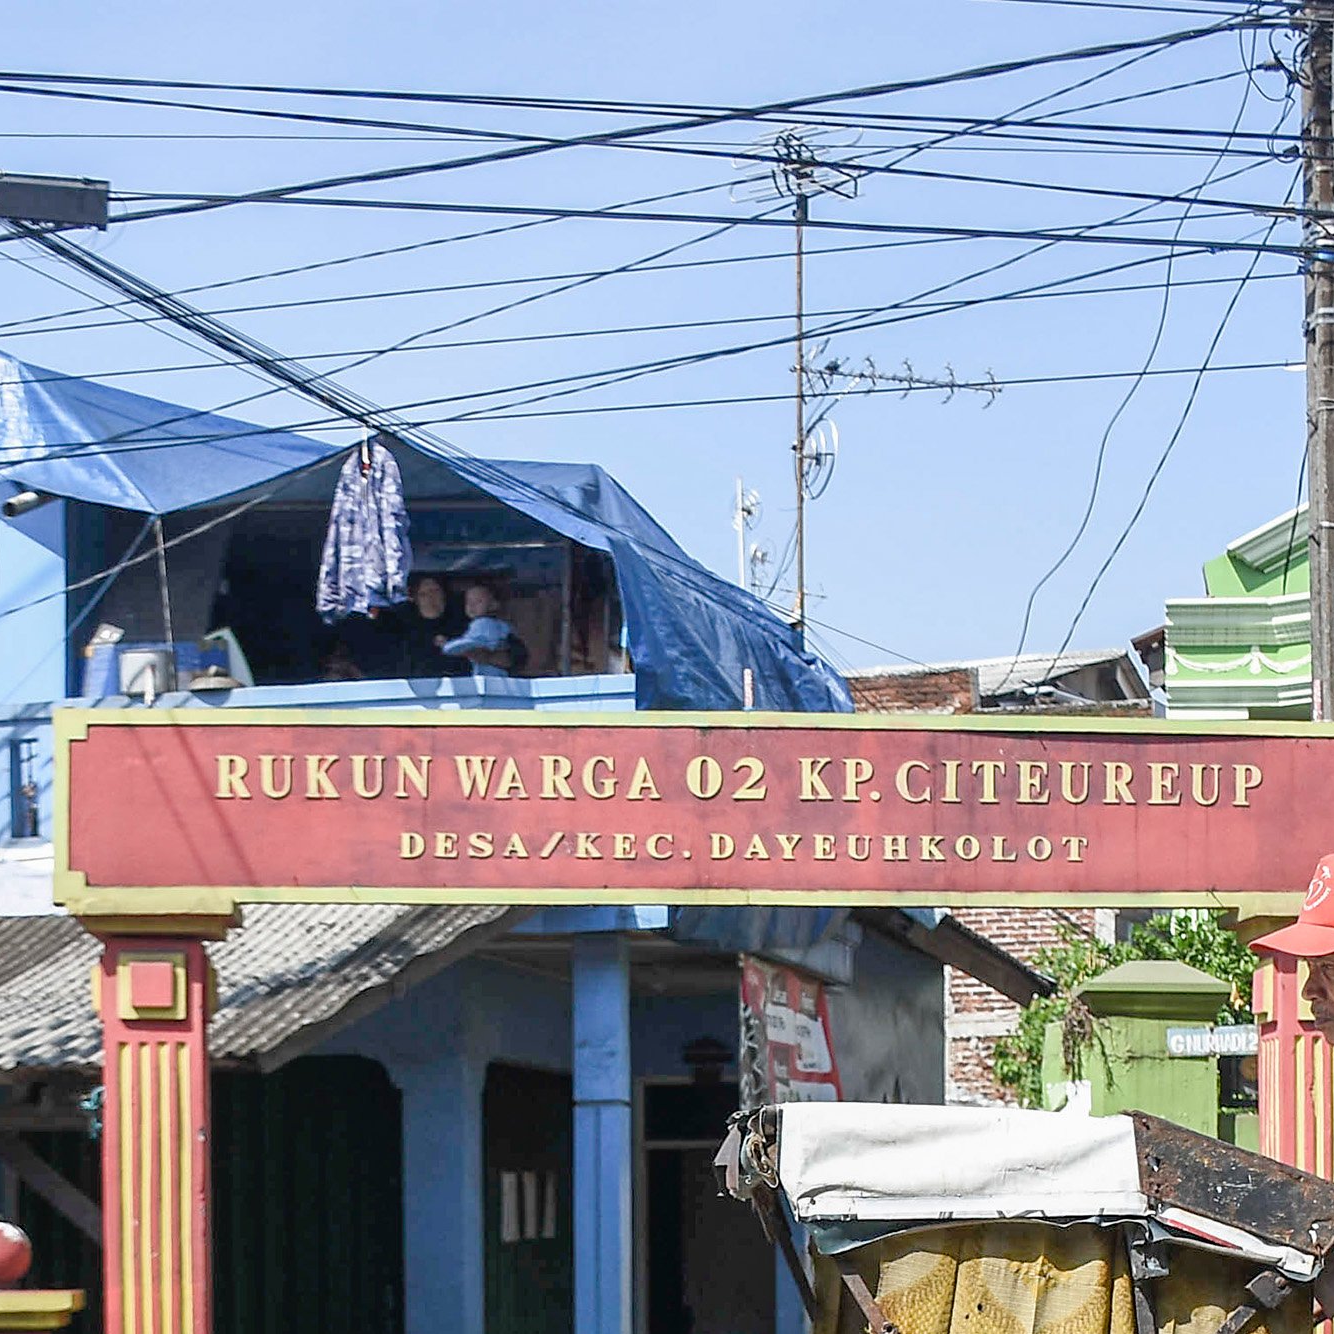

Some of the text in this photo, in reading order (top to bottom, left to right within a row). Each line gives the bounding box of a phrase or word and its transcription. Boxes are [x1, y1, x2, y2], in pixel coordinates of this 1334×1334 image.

[215, 754, 432, 799] RUKUN
[454, 755, 661, 801] WARGA
[399, 831, 1088, 864] DESA/KEC. DAYEUHKOLOT
